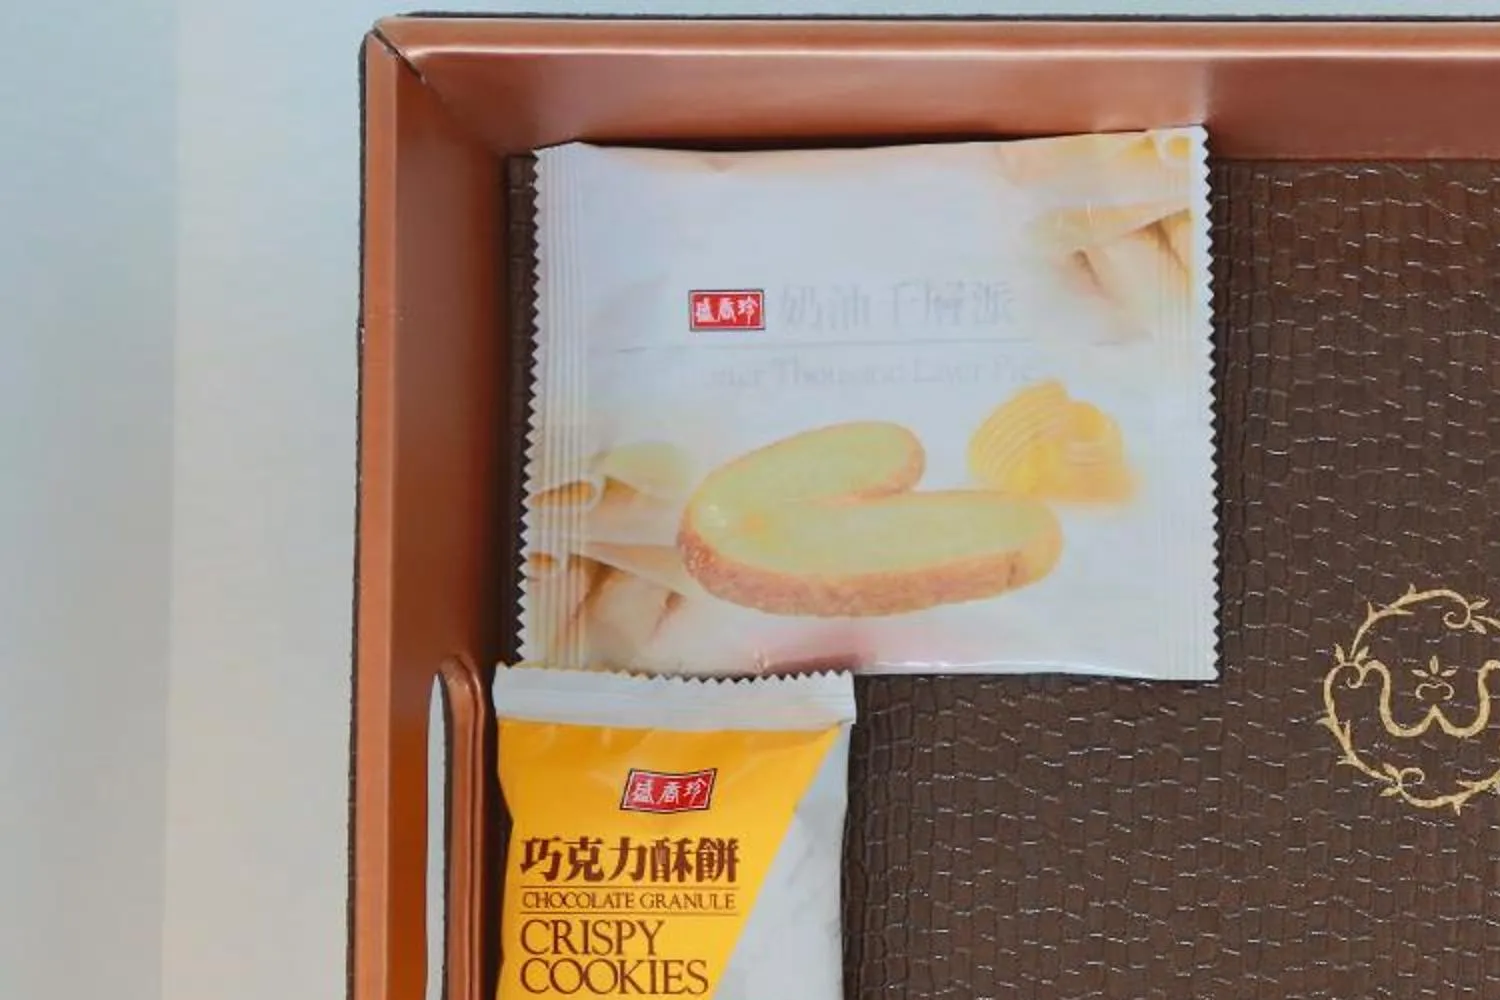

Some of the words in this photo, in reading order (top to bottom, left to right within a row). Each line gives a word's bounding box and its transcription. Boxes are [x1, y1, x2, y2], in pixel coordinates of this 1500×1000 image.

[520, 836, 740, 883] 巧克力酥餅
[522, 891, 635, 909] CHOCOLATE
[639, 892, 736, 910] GRANULE
[520, 919, 666, 956] CRISPY
[520, 957, 709, 995] COOKIES
